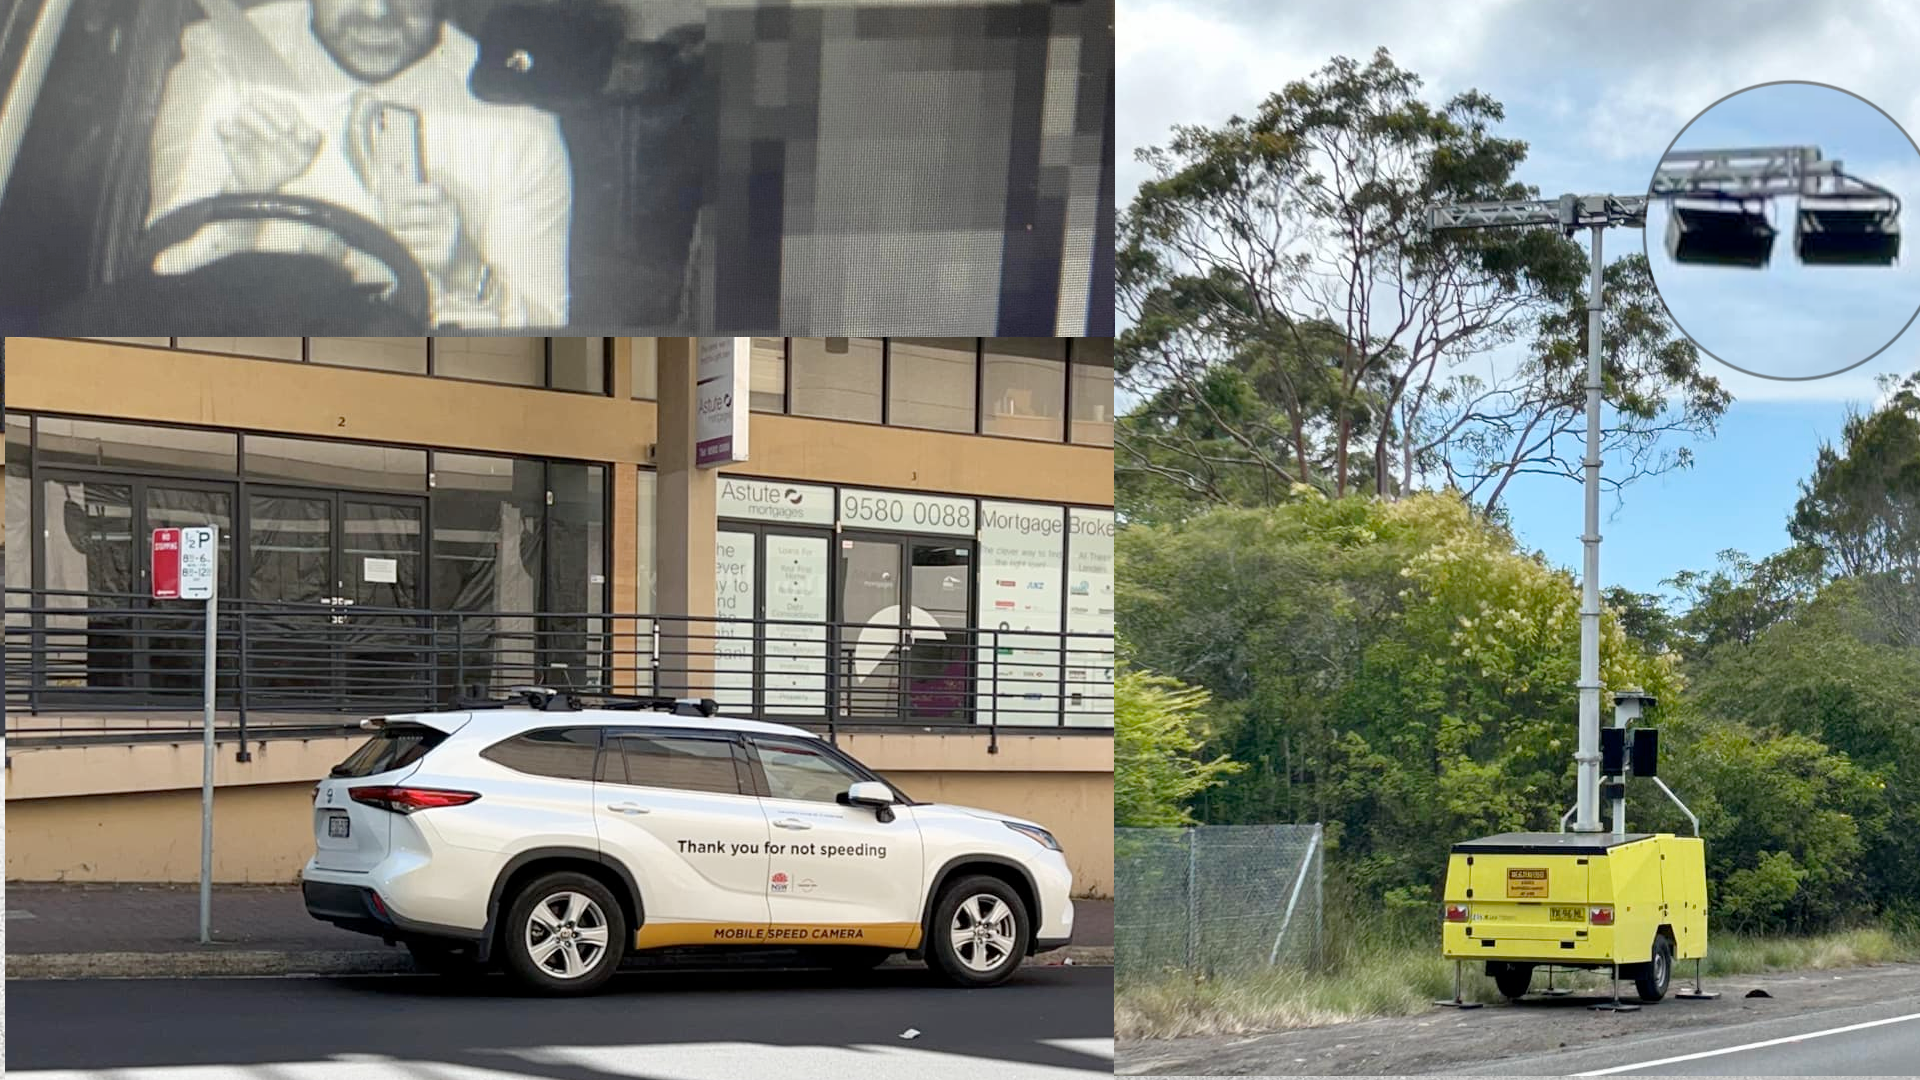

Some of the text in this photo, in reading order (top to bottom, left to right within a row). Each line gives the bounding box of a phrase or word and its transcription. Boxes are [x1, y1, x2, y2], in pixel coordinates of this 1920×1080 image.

[337, 416, 346, 427] 2
[721, 481, 781, 504] Astute
[749, 504, 804, 519] mortgages
[844, 495, 971, 528] 9580 0088
[981, 509, 1115, 537] Mortgage Broke
[199, 532, 210, 549] P
[717, 542, 735, 558] he
[717, 562, 745, 575] ever
[733, 578, 749, 593] to
[677, 840, 887, 858] Thank you for not speeding
[713, 928, 864, 939] MOBILE SPEED CAMERA
